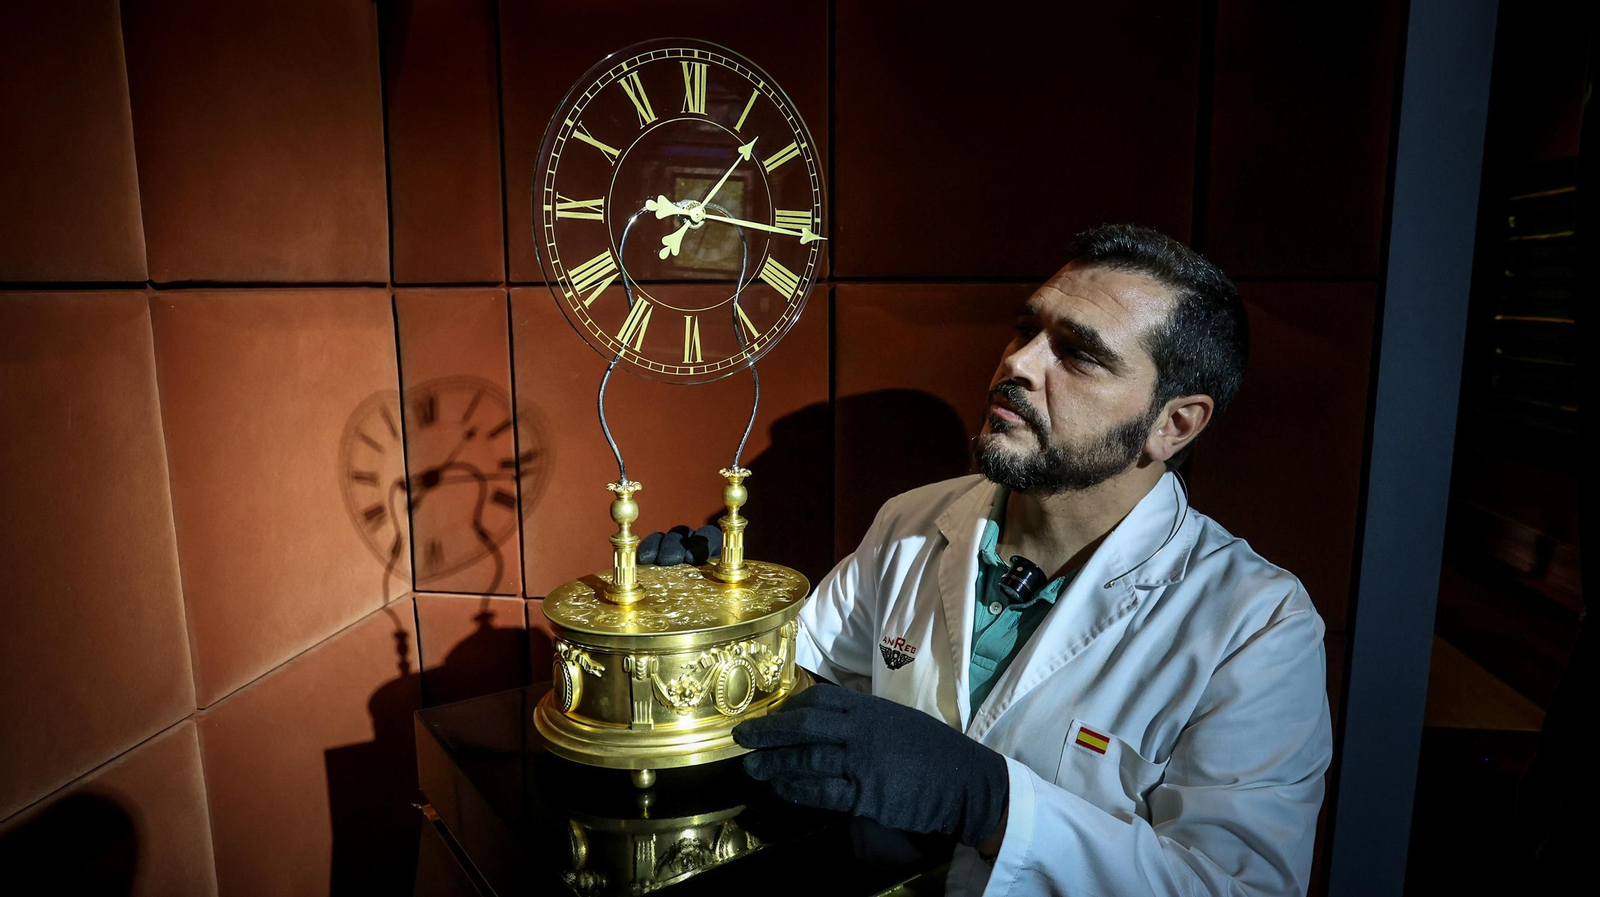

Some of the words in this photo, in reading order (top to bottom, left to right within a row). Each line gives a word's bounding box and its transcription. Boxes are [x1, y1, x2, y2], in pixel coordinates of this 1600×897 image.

[617, 71, 658, 129] XI
[679, 61, 710, 116] XII
[735, 88, 761, 132] I
[572, 121, 622, 166] X
[762, 139, 801, 174] II
[556, 192, 605, 223] IX
[775, 208, 812, 232] III
[567, 247, 621, 309] VIII
[758, 254, 801, 302] IIII
[615, 295, 654, 352] VII
[683, 315, 704, 363] VI
[735, 302, 761, 345] V
